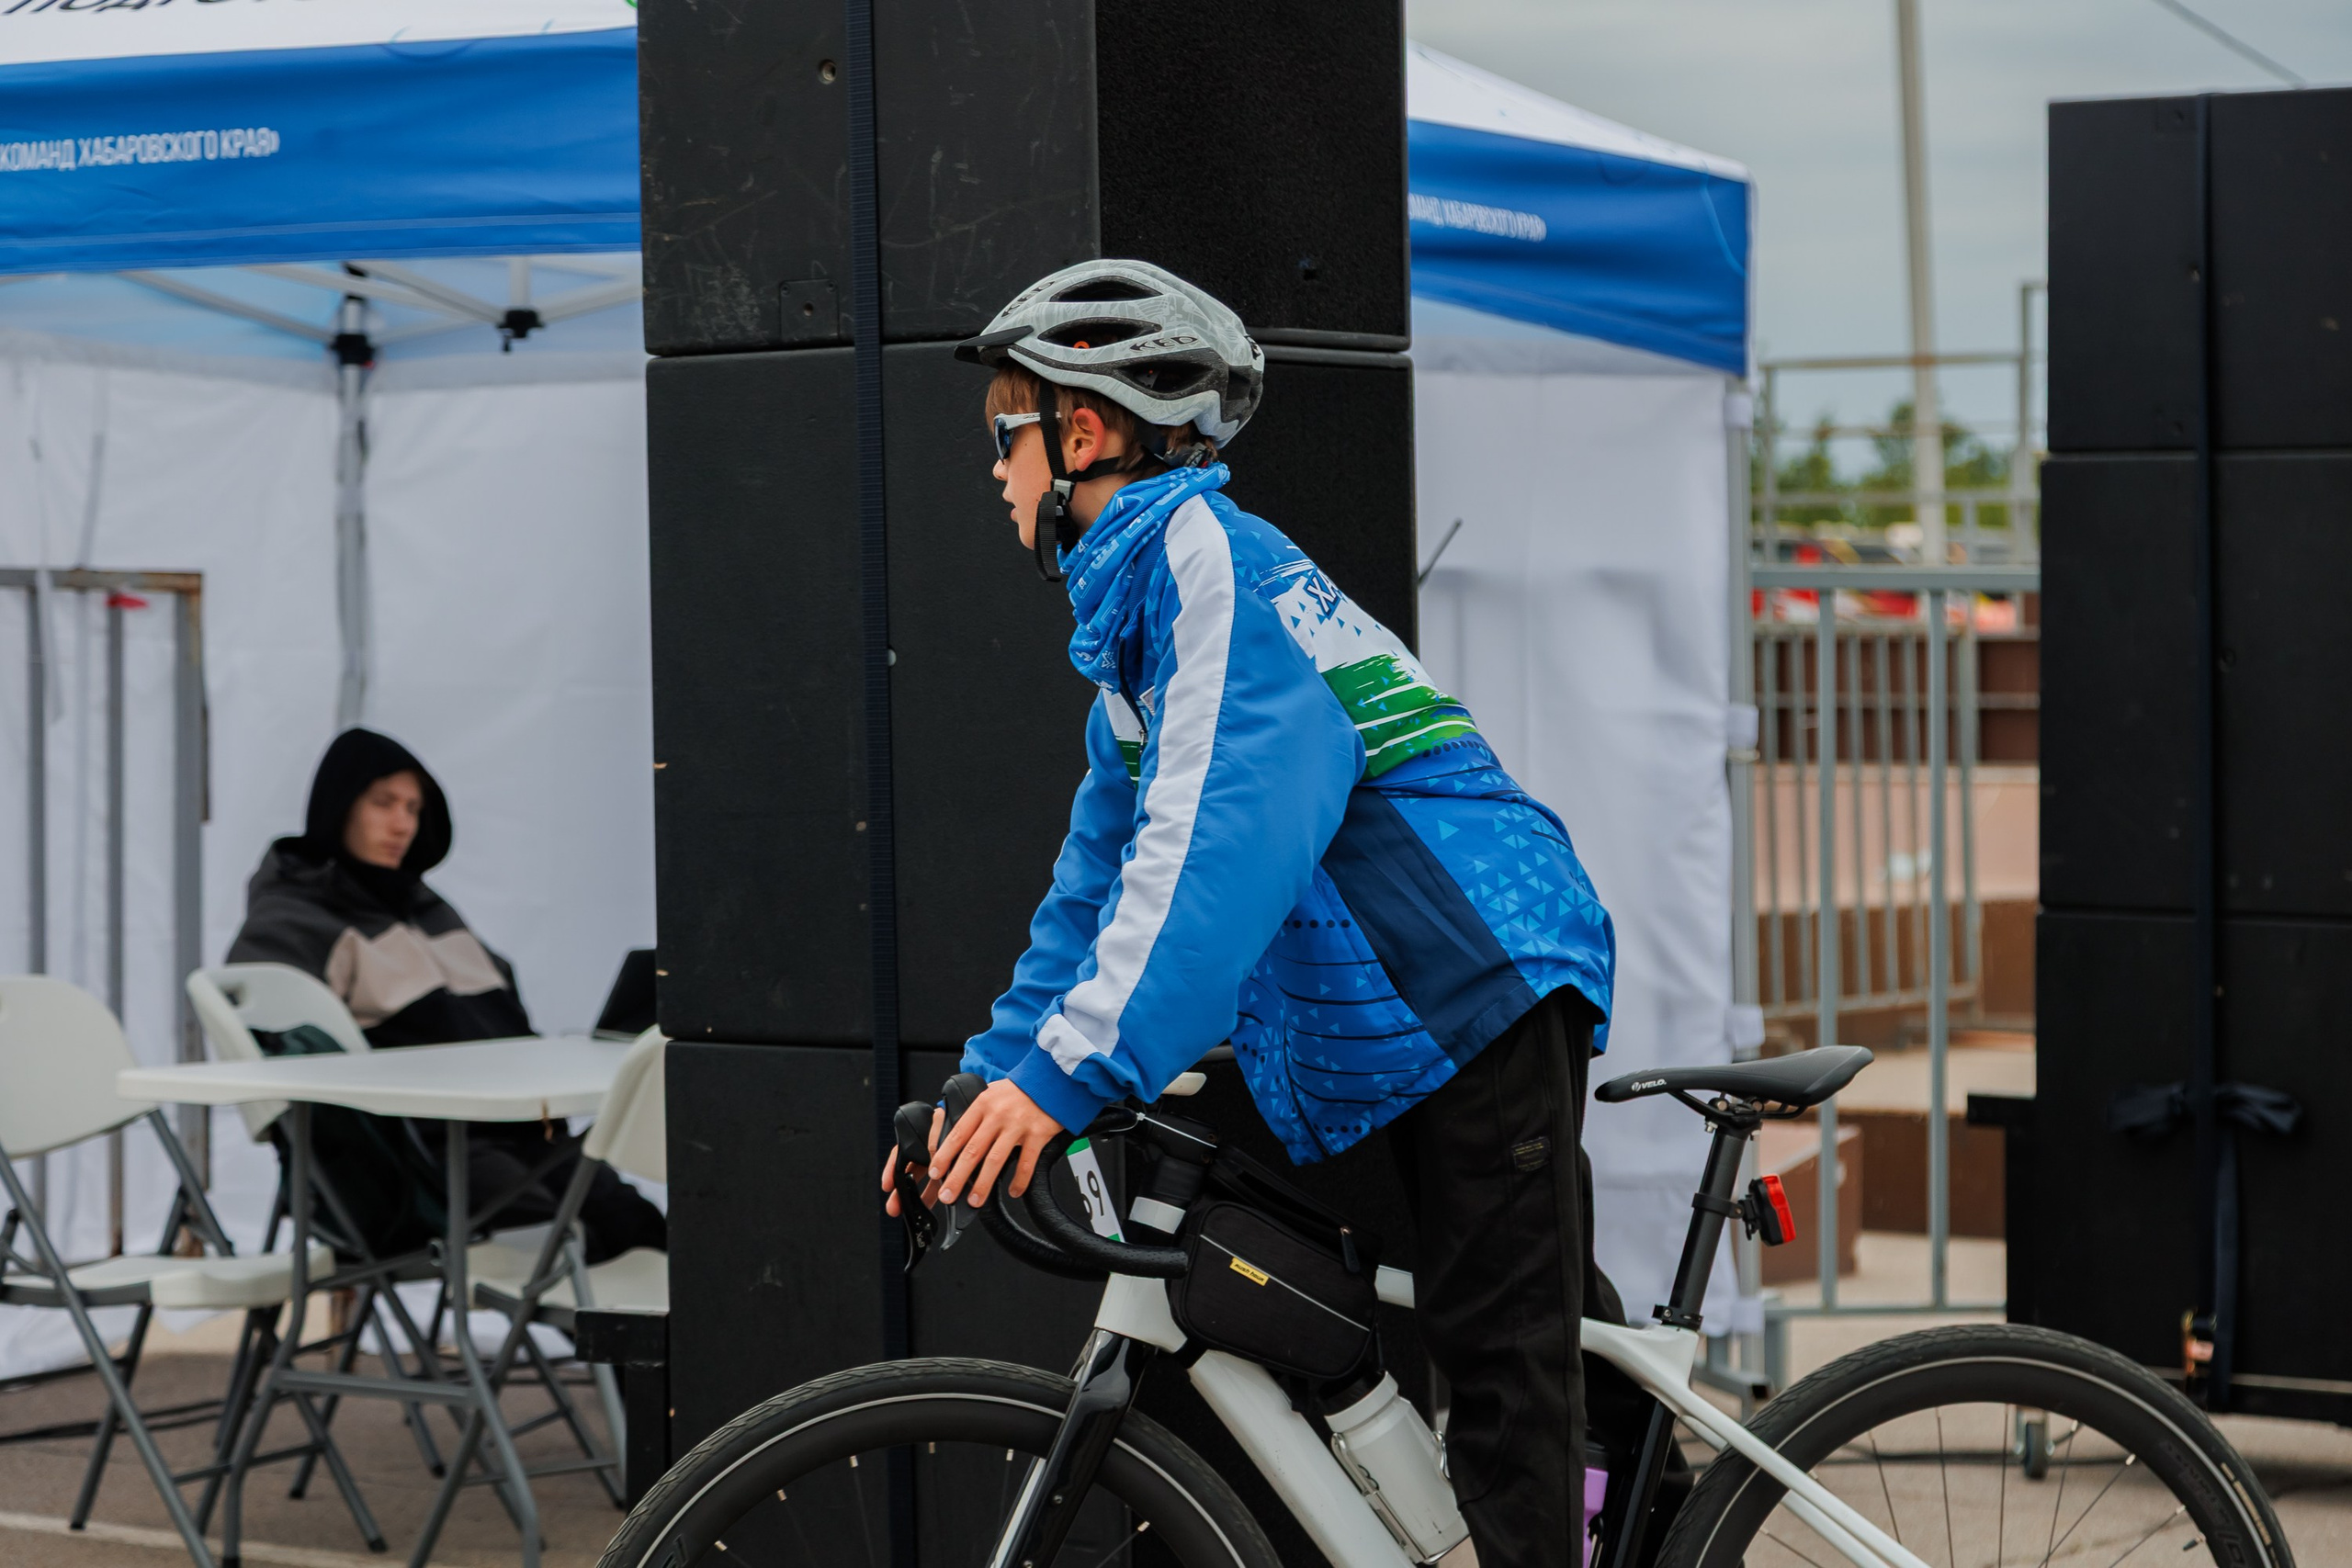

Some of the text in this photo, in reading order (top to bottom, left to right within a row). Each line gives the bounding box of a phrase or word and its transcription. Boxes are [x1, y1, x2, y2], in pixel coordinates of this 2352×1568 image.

[77, 130, 219, 167] ХАБАРОВСКОГО
[1001, 280, 1056, 318] KED
[1129, 335, 1198, 351] KED
